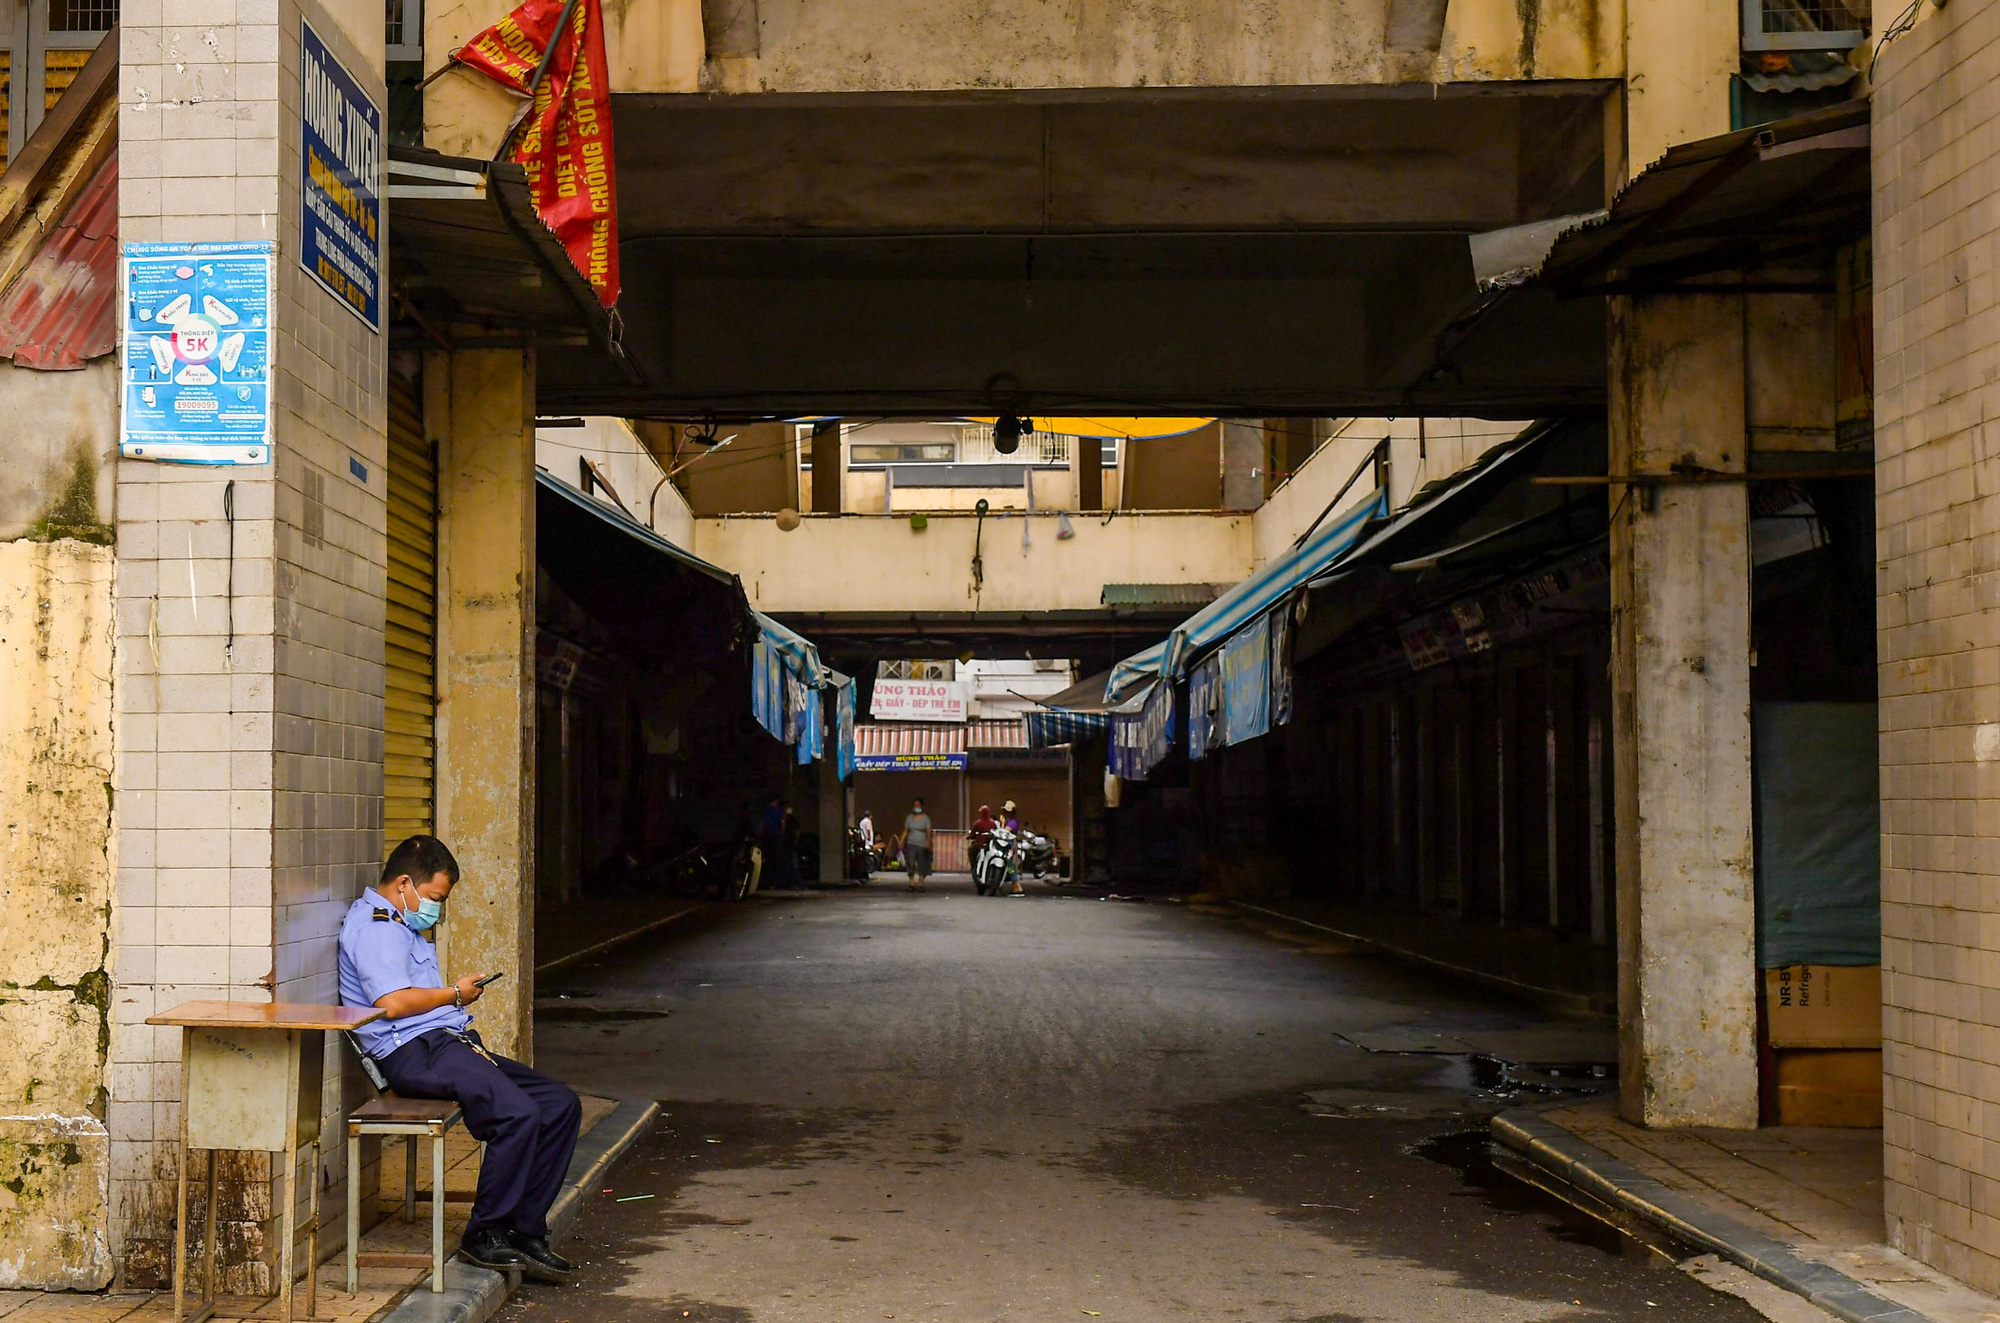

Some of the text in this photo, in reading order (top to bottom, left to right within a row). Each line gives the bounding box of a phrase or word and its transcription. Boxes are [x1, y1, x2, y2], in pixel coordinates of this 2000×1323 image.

[476, 34, 508, 65] GIA
[304, 47, 343, 162] HOÀNG
[345, 98, 378, 200] XUYẾN
[568, 98, 599, 137] SỐT
[555, 154, 578, 197] DIỆT
[580, 142, 609, 212] CHỐNG
[587, 218, 609, 287] PHÒNG
[186, 337, 208, 352] 5K
[177, 401, 216, 409] 19009095
[908, 683, 946, 696] THẢO
[912, 698, 928, 708] DÉP
[948, 699, 961, 709] EM
